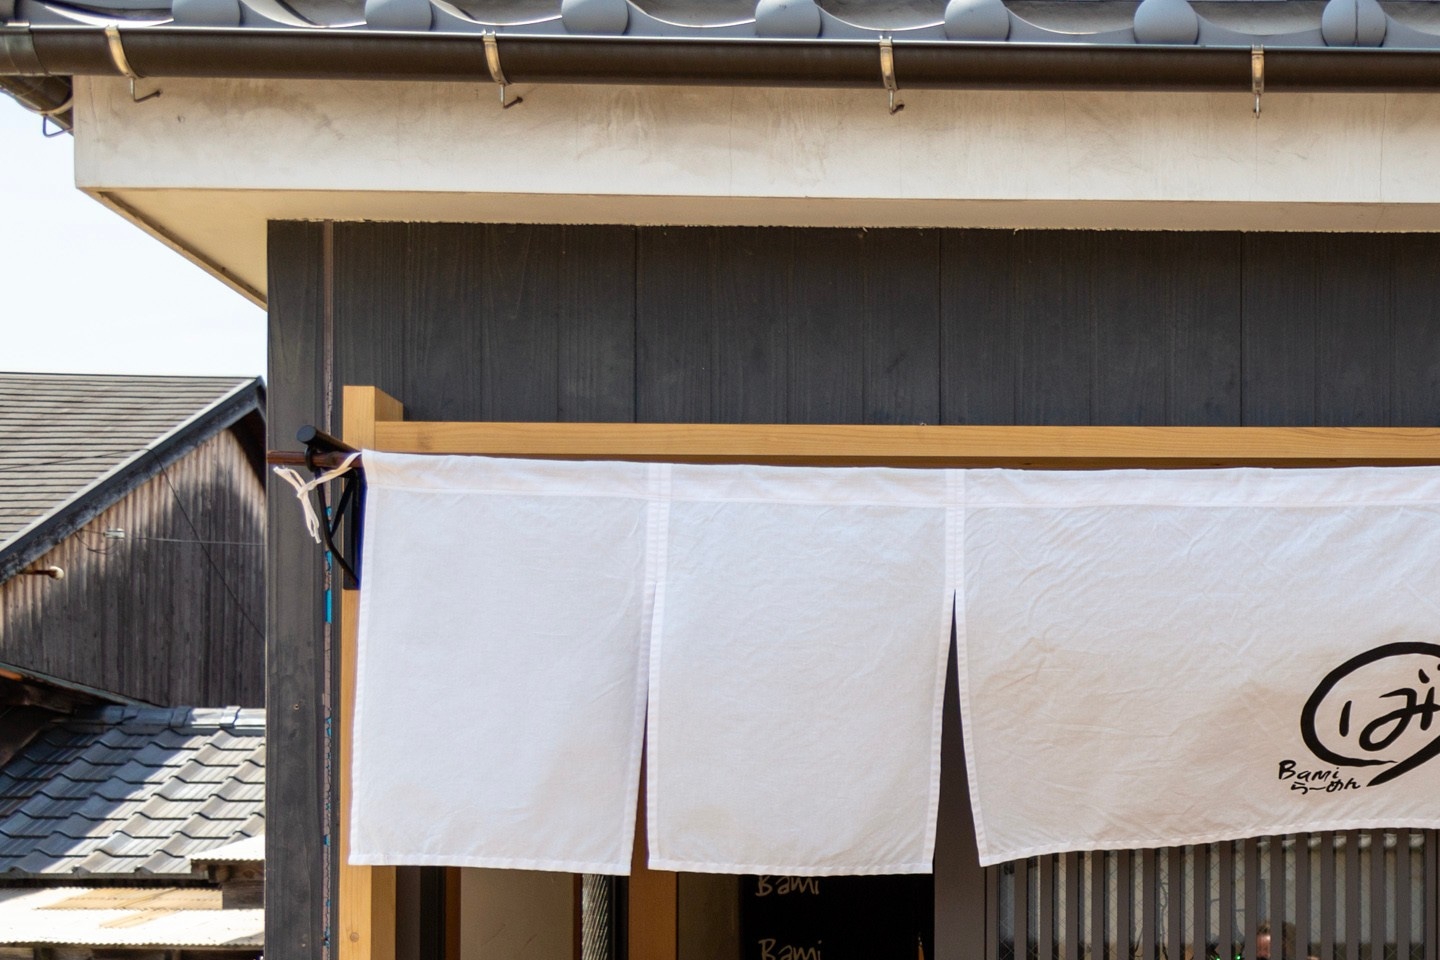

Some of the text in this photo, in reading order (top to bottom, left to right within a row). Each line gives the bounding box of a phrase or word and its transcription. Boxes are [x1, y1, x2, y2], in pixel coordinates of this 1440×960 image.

[1278, 760, 1340, 782] Bami
[1291, 778, 1361, 795] らーめん
